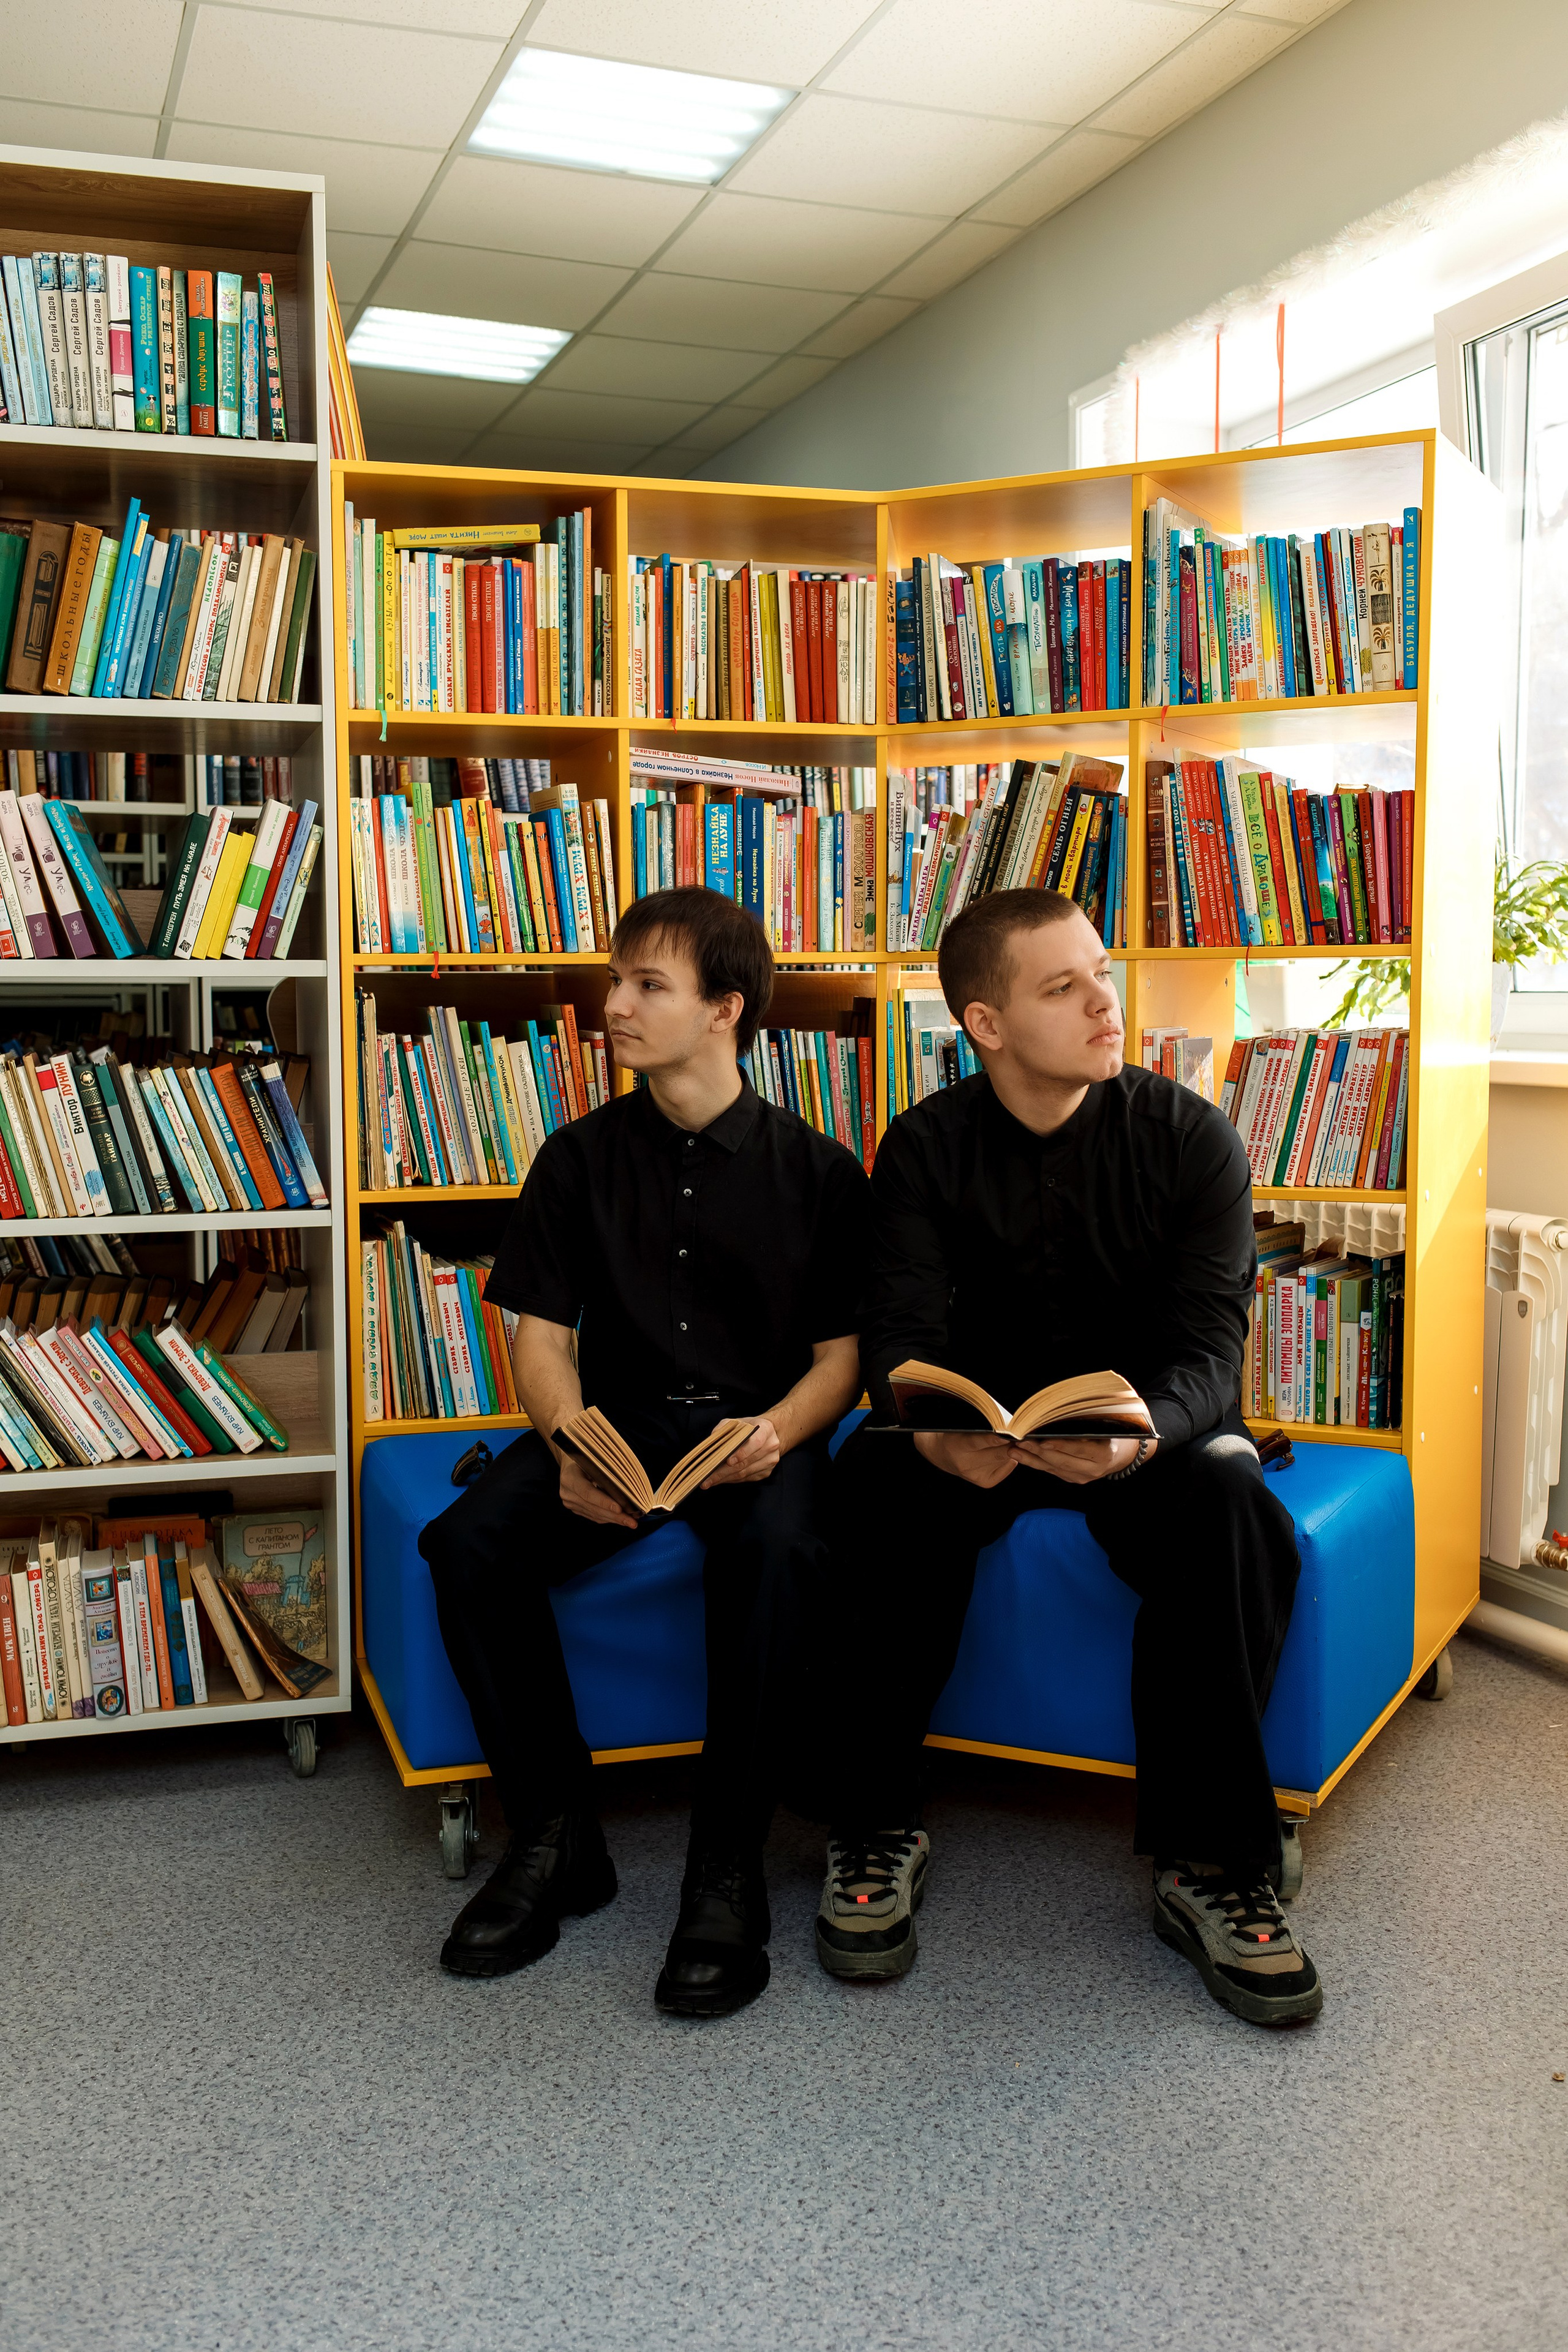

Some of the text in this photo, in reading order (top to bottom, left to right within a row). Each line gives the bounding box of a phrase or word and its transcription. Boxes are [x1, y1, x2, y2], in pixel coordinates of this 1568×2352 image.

[48, 296, 60, 353] Сергей Садов
[73, 326, 82, 355] Сергей
[92, 299, 104, 355] Сергей Садов
[269, 350, 278, 372] ДЕЛО
[76, 533, 91, 575] ГОДЫ
[1354, 537, 1368, 619] Корней ЧУКОВСКИЙ
[1406, 565, 1415, 616] ДЕДУШКА
[153, 627, 162, 643] ПОЛКА
[1310, 610, 1319, 645] ЗАПРЕЩЕНО!
[1406, 622, 1415, 666] БАБУЛЯ,
[657, 765, 693, 775] Солнечном
[702, 772, 733, 780] Незнайка
[281, 823, 294, 854] АНТАРКТИДА
[399, 818, 407, 846] ЧУДЕС
[710, 806, 720, 864] НЕЗНАЙКА
[893, 791, 904, 852] Винни-Пух
[985, 815, 997, 845] ЭЛЕКТРОНИКА
[1052, 797, 1073, 862] СЕМЬ ОГНЕЙ
[1231, 791, 1250, 885] ПУТЕШЕСТВИЯ ГУЛЛИВЕРА
[1310, 803, 1321, 837] Шарлотты
[720, 843, 728, 858] НА
[865, 814, 875, 902] Эмма МОШКОВСКАЯ
[164, 842, 197, 942] ЛИНДГРЕН ПУТЬ ЗМЕЯ НА СКАЛЕ
[571, 850, 589, 921] ХРУМ ХРУМ
[1064, 865, 1072, 883] моей
[1350, 857, 1363, 930] ЭВКАЛИПТОВЫЙ ПРИШЕЛЕЦ
[594, 903, 604, 934] РАССКАЗЫ
[55, 1061, 74, 1096] ЛУНИН
[518, 1055, 527, 1090] САЛЬТКРОКА
[1244, 1058, 1261, 1111] СКАЗОЧНЫЕ ПОВЕСТИ
[220, 1071, 265, 1161] ВОДИТЕЛИ ФРЕГАТОВ
[458, 1057, 478, 1134] ЗОЛОТЫЕ РУКИ
[524, 1091, 533, 1115] ОСТРОВЕ
[249, 1096, 271, 1143] ХРАНИТЕЛИ
[104, 1133, 117, 1163] ГАЙДАР
[1280, 1286, 1293, 1384] ПИТОМЦЫ ЗООПАРКА
[39, 1382, 49, 1395] ВАШЕ
[87, 1338, 131, 1396] ТАЙНА ТРЕТЬЕЙ ПЛАНЕТЫ
[168, 1338, 244, 1435] КИР БУЛЫЧЕВ Девочка Земли
[50, 1341, 124, 1440] КИР БУЛЫЧЕВ Девочка Земли
[255, 1534, 300, 1544] КАПИТАНОМ
[3, 1618, 15, 1661] МАРК ТВЕН
